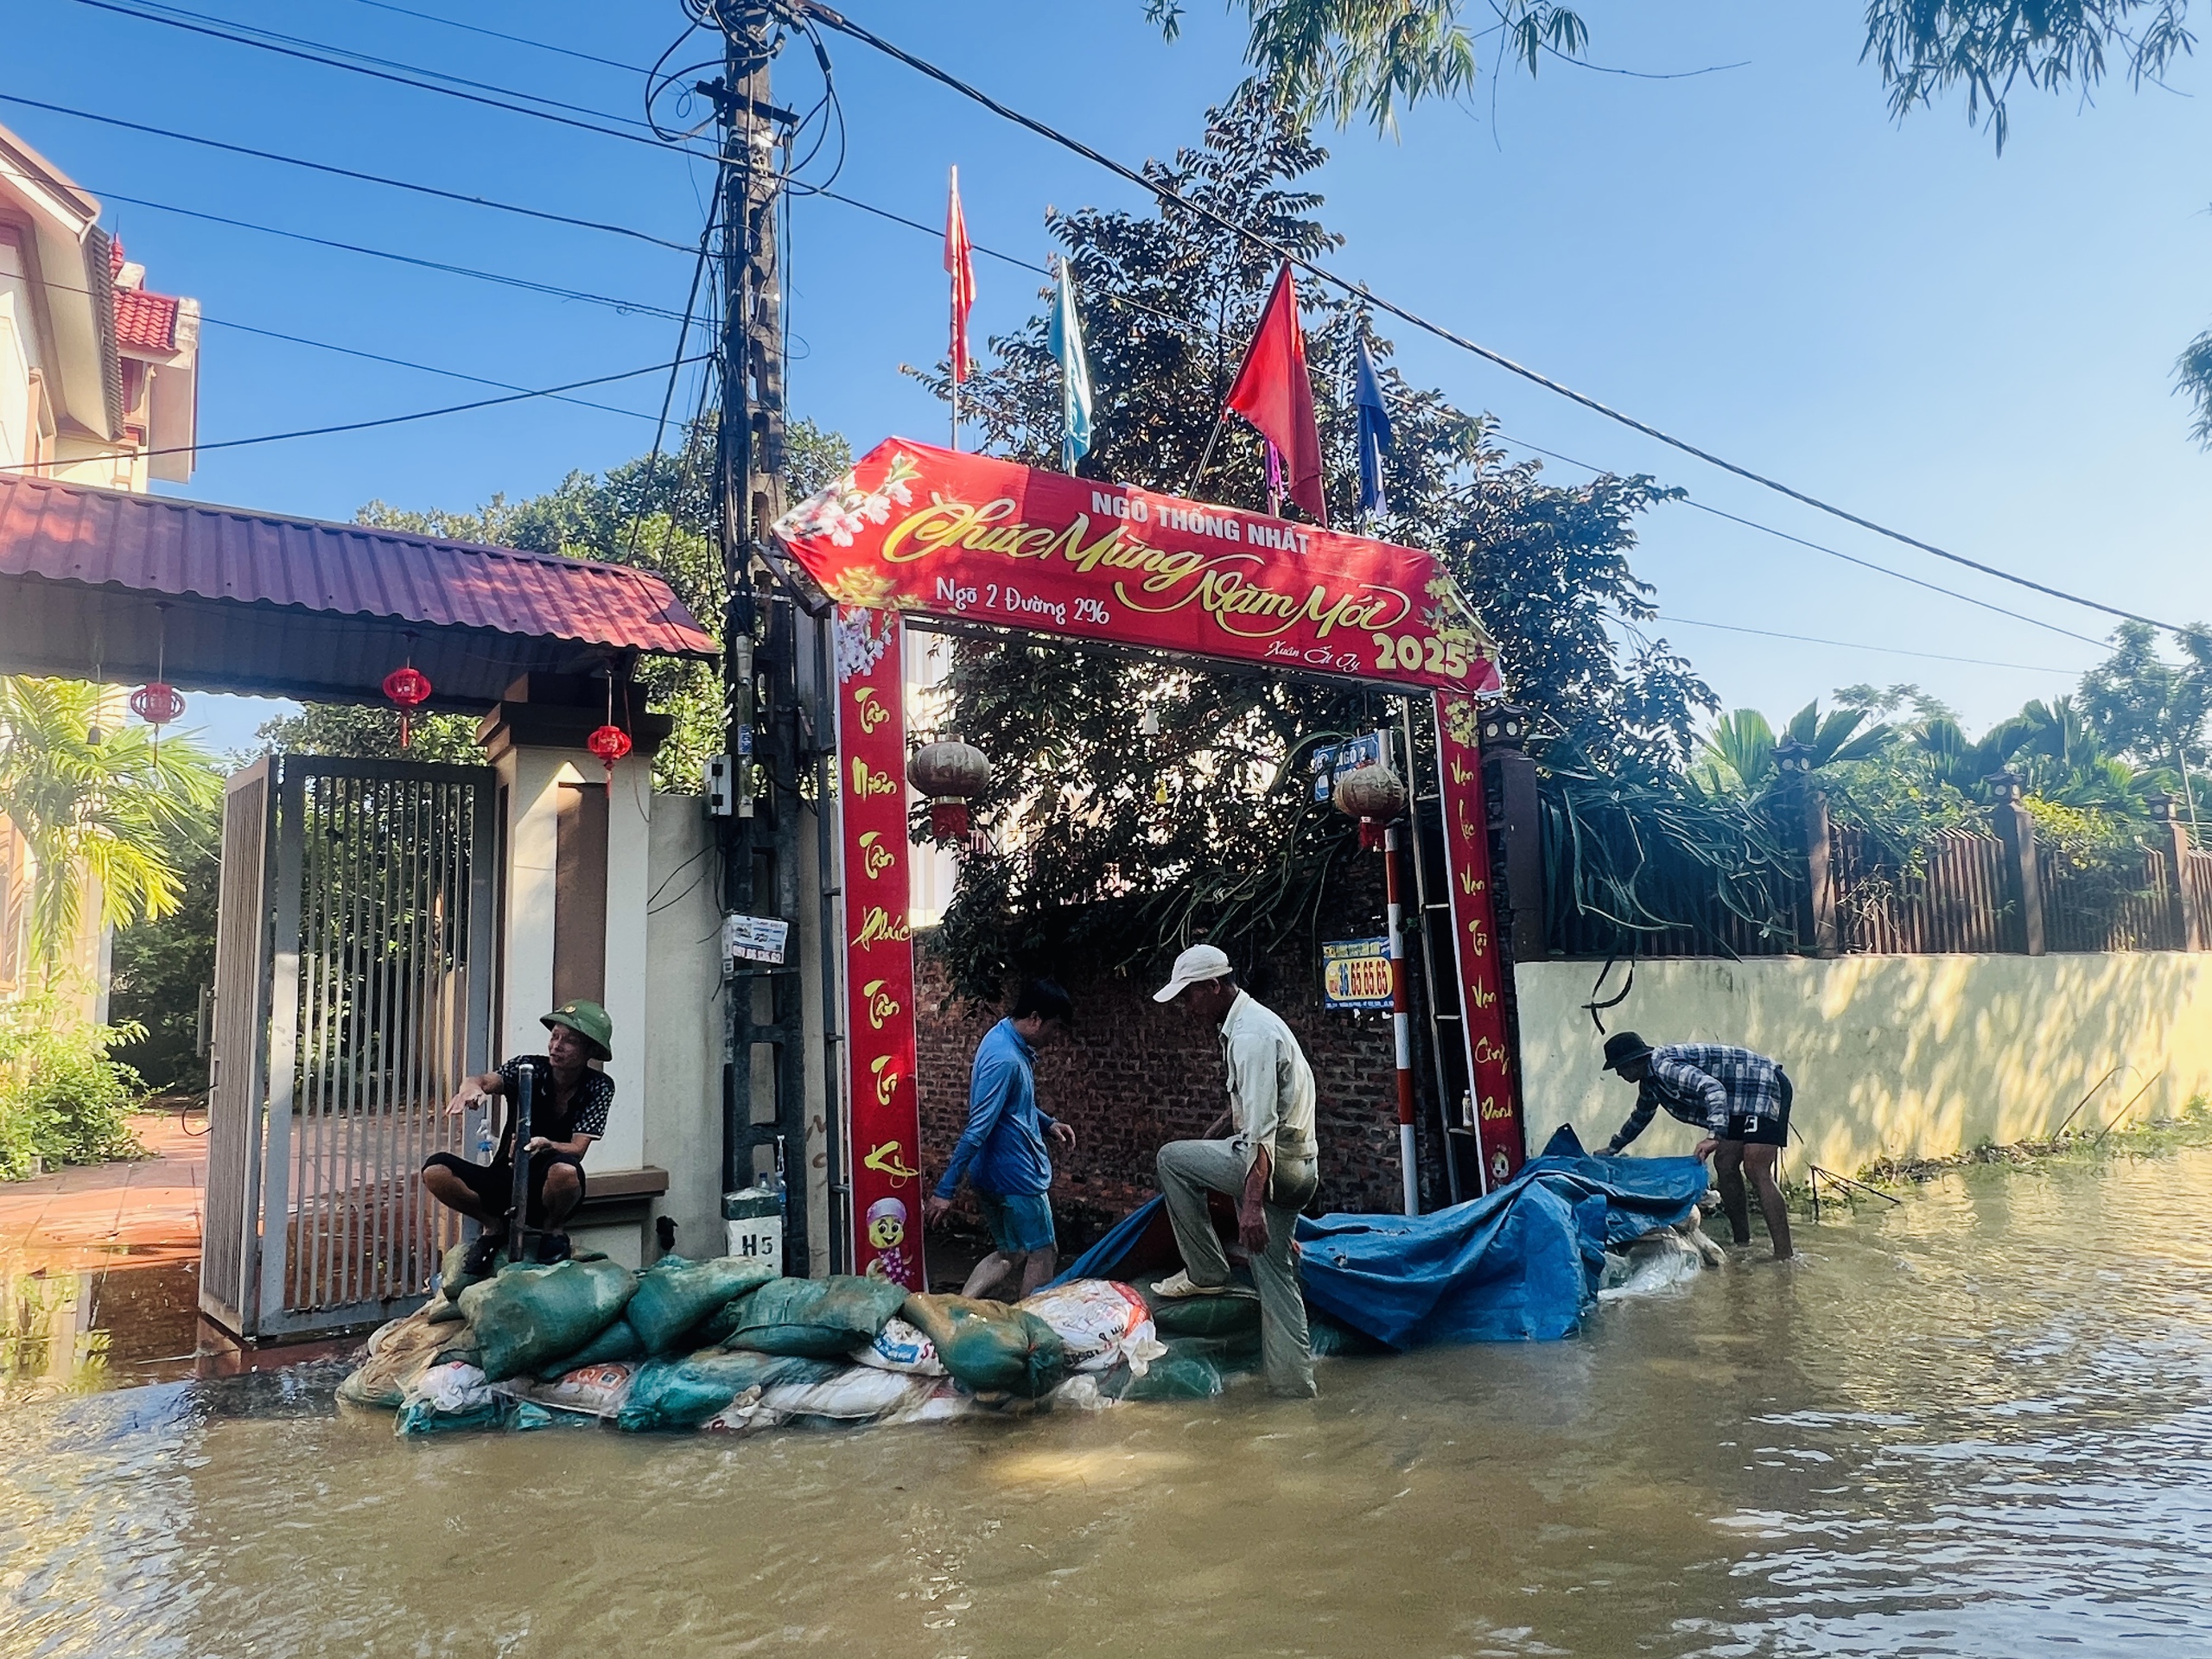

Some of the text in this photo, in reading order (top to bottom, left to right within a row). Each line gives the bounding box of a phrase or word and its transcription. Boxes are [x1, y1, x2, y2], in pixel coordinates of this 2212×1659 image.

[882, 491, 1056, 563] Chúc
[1039, 512, 1264, 592] Mừng
[1091, 490, 1310, 555] NGÕ THỐNG NHẤT
[936, 576, 1110, 626] Ngõ 2 Đường 296
[1263, 640, 1300, 658] Xuân
[1372, 632, 1469, 679] 2025
[854, 686, 890, 734] Tân
[852, 756, 898, 801] Niên
[1450, 753, 1474, 787] Vạn
[859, 831, 895, 880] Tân
[1460, 862, 1485, 896] Vạn
[850, 906, 912, 952] Phúc
[864, 980, 900, 1030] Tân
[1471, 975, 1497, 1009] Vạn
